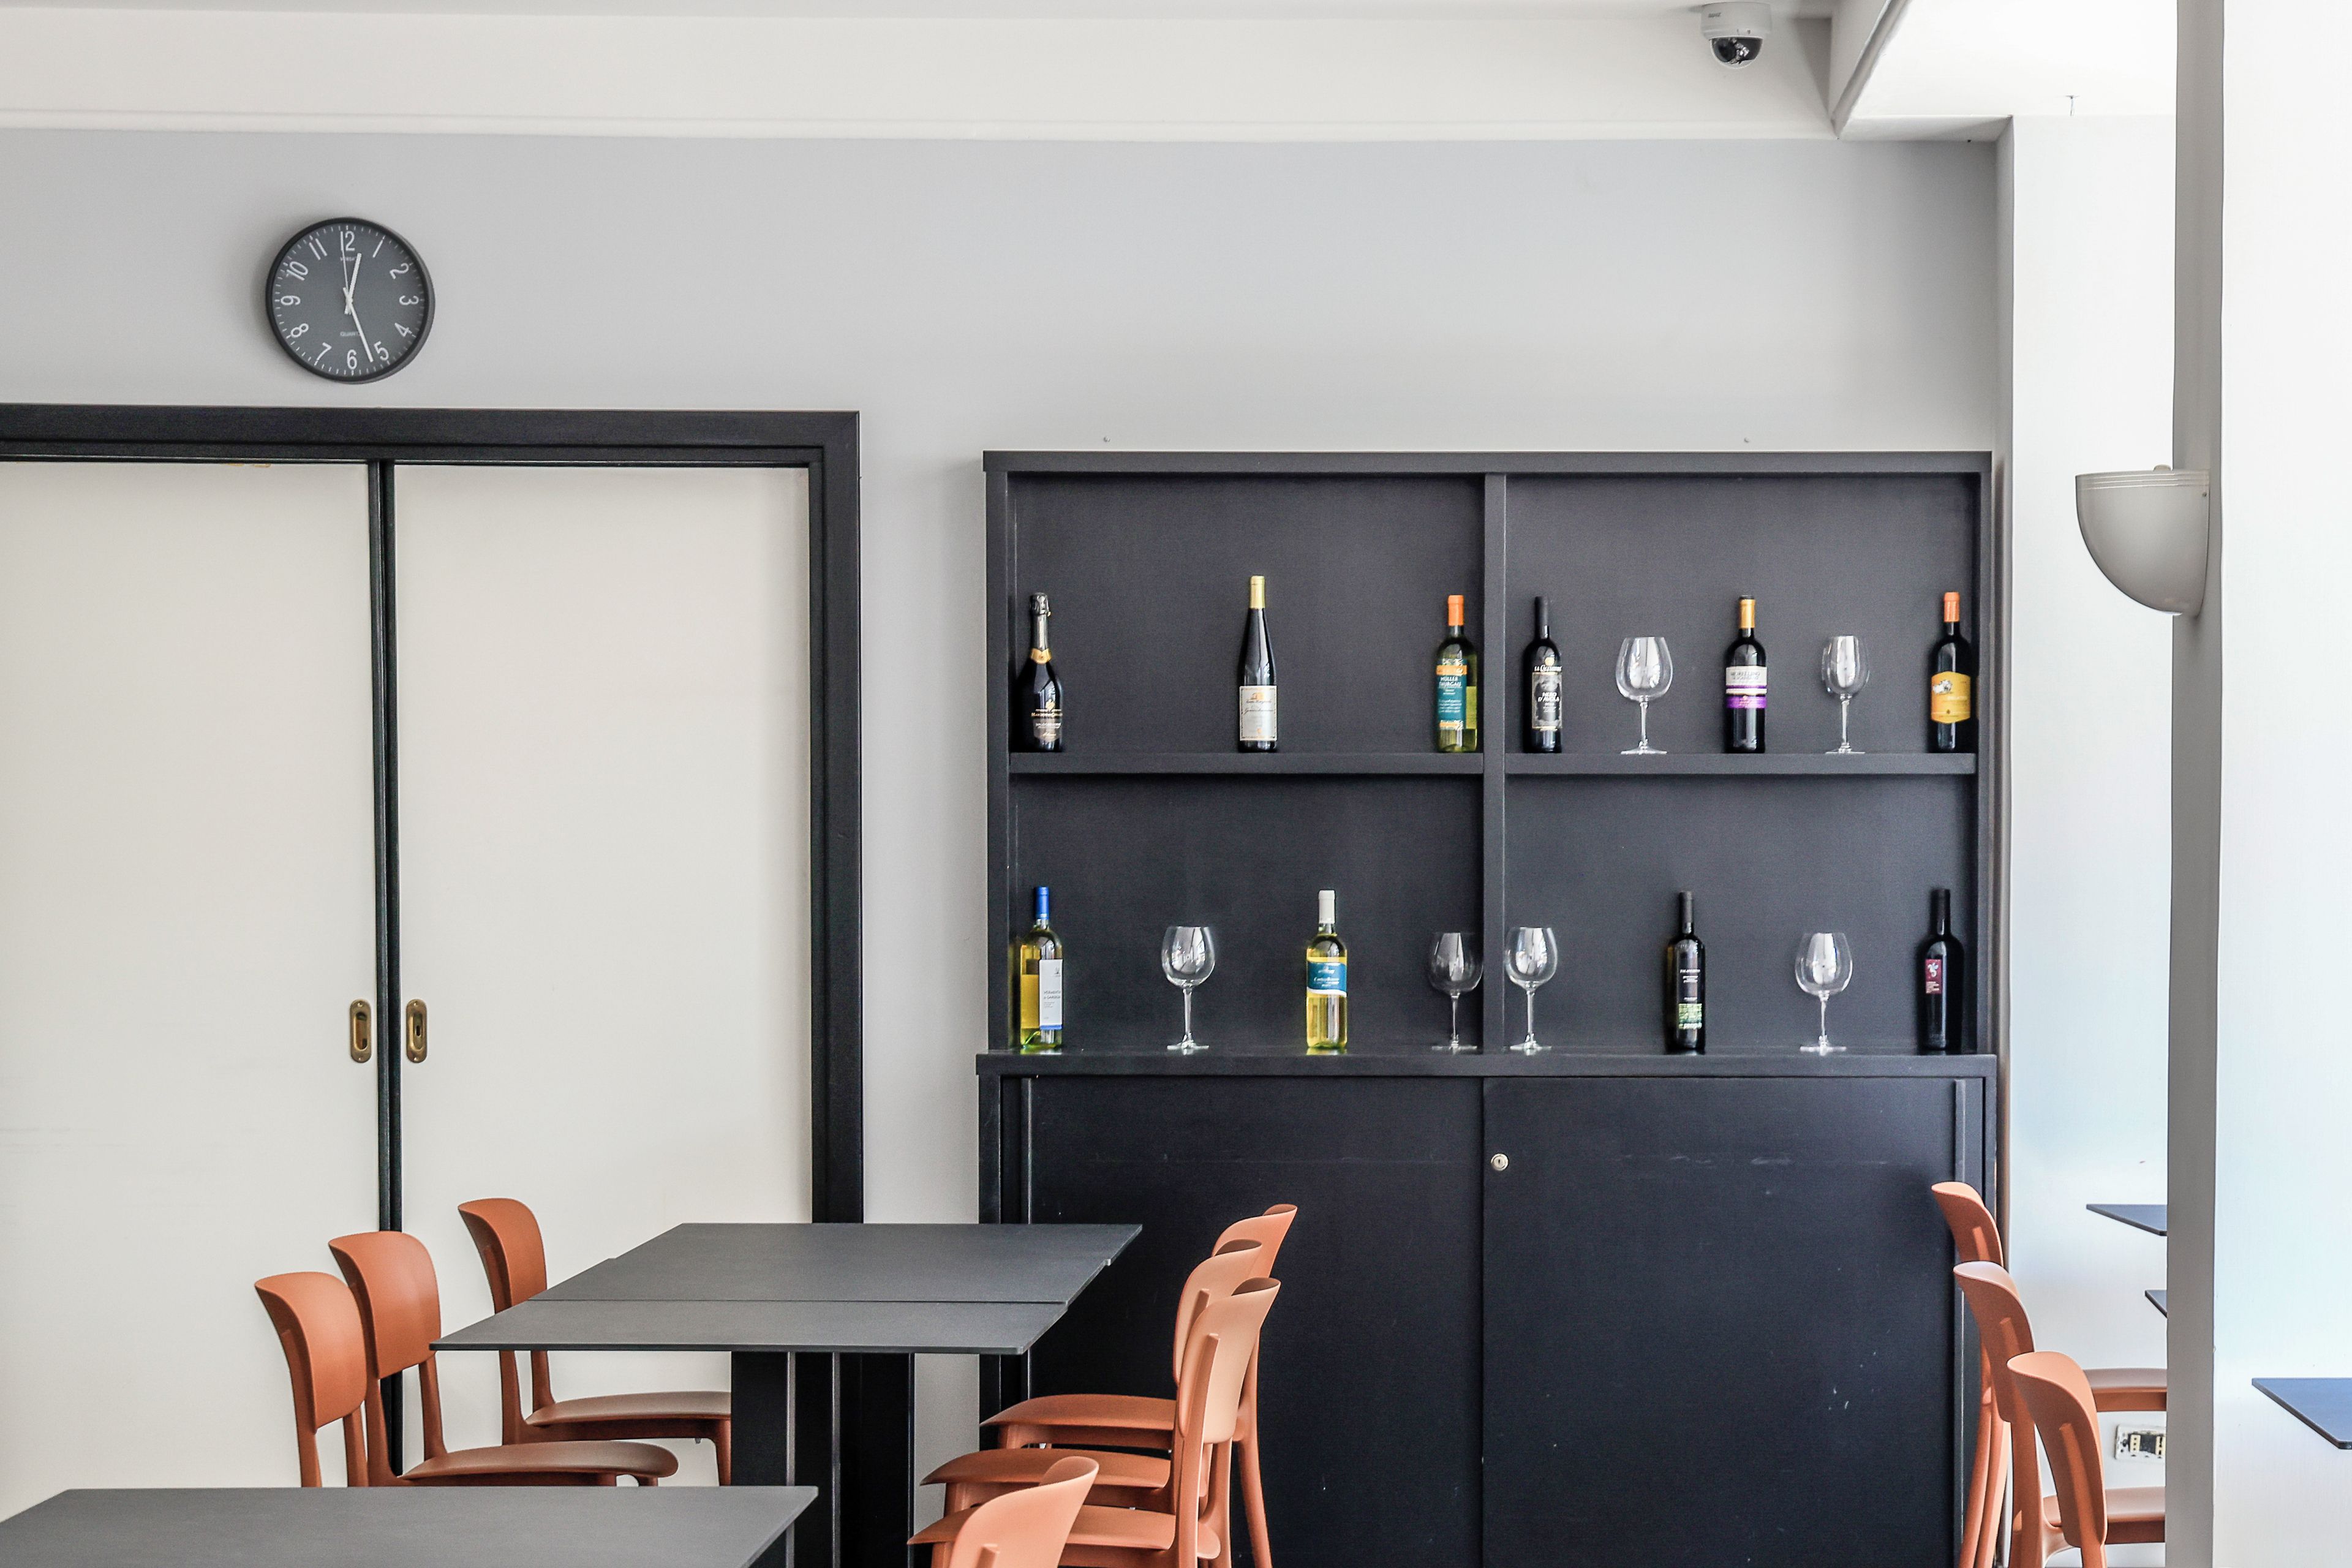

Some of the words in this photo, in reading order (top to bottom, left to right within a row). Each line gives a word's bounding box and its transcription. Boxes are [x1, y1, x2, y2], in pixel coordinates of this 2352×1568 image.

[309, 238, 328, 260] 11
[340, 230, 356, 251] 12
[372, 239, 383, 258] 1
[285, 260, 309, 281] 10
[389, 263, 409, 279] 2
[281, 295, 301, 306] 9
[399, 295, 419, 306] 3
[290, 323, 309, 338] 8
[394, 322, 412, 337] 4
[316, 342, 332, 361] 7
[347, 349, 358, 369] 6
[374, 341, 390, 361] 5
